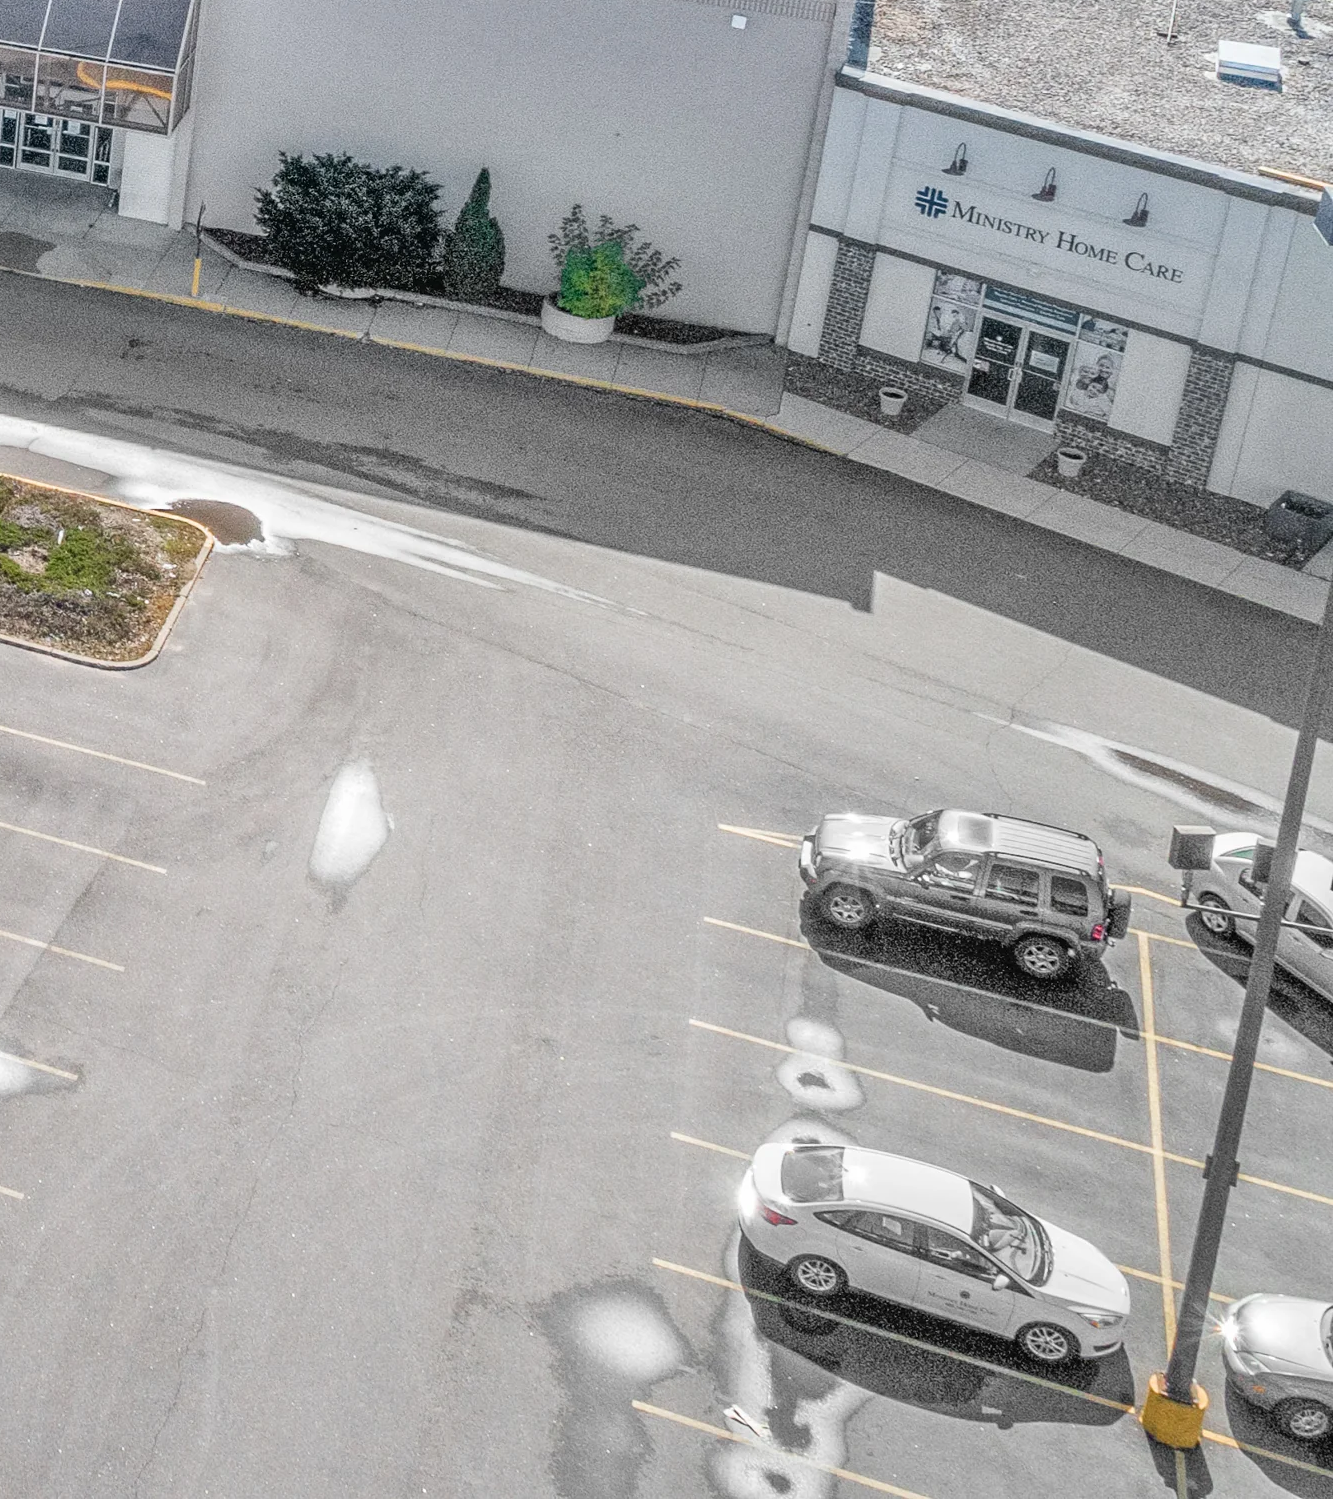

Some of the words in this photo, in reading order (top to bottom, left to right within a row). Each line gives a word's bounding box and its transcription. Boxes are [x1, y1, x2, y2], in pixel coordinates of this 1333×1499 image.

[951, 200, 1050, 244] MINISTRY
[1056, 230, 1119, 265] HOME
[1124, 251, 1184, 284] CARE
